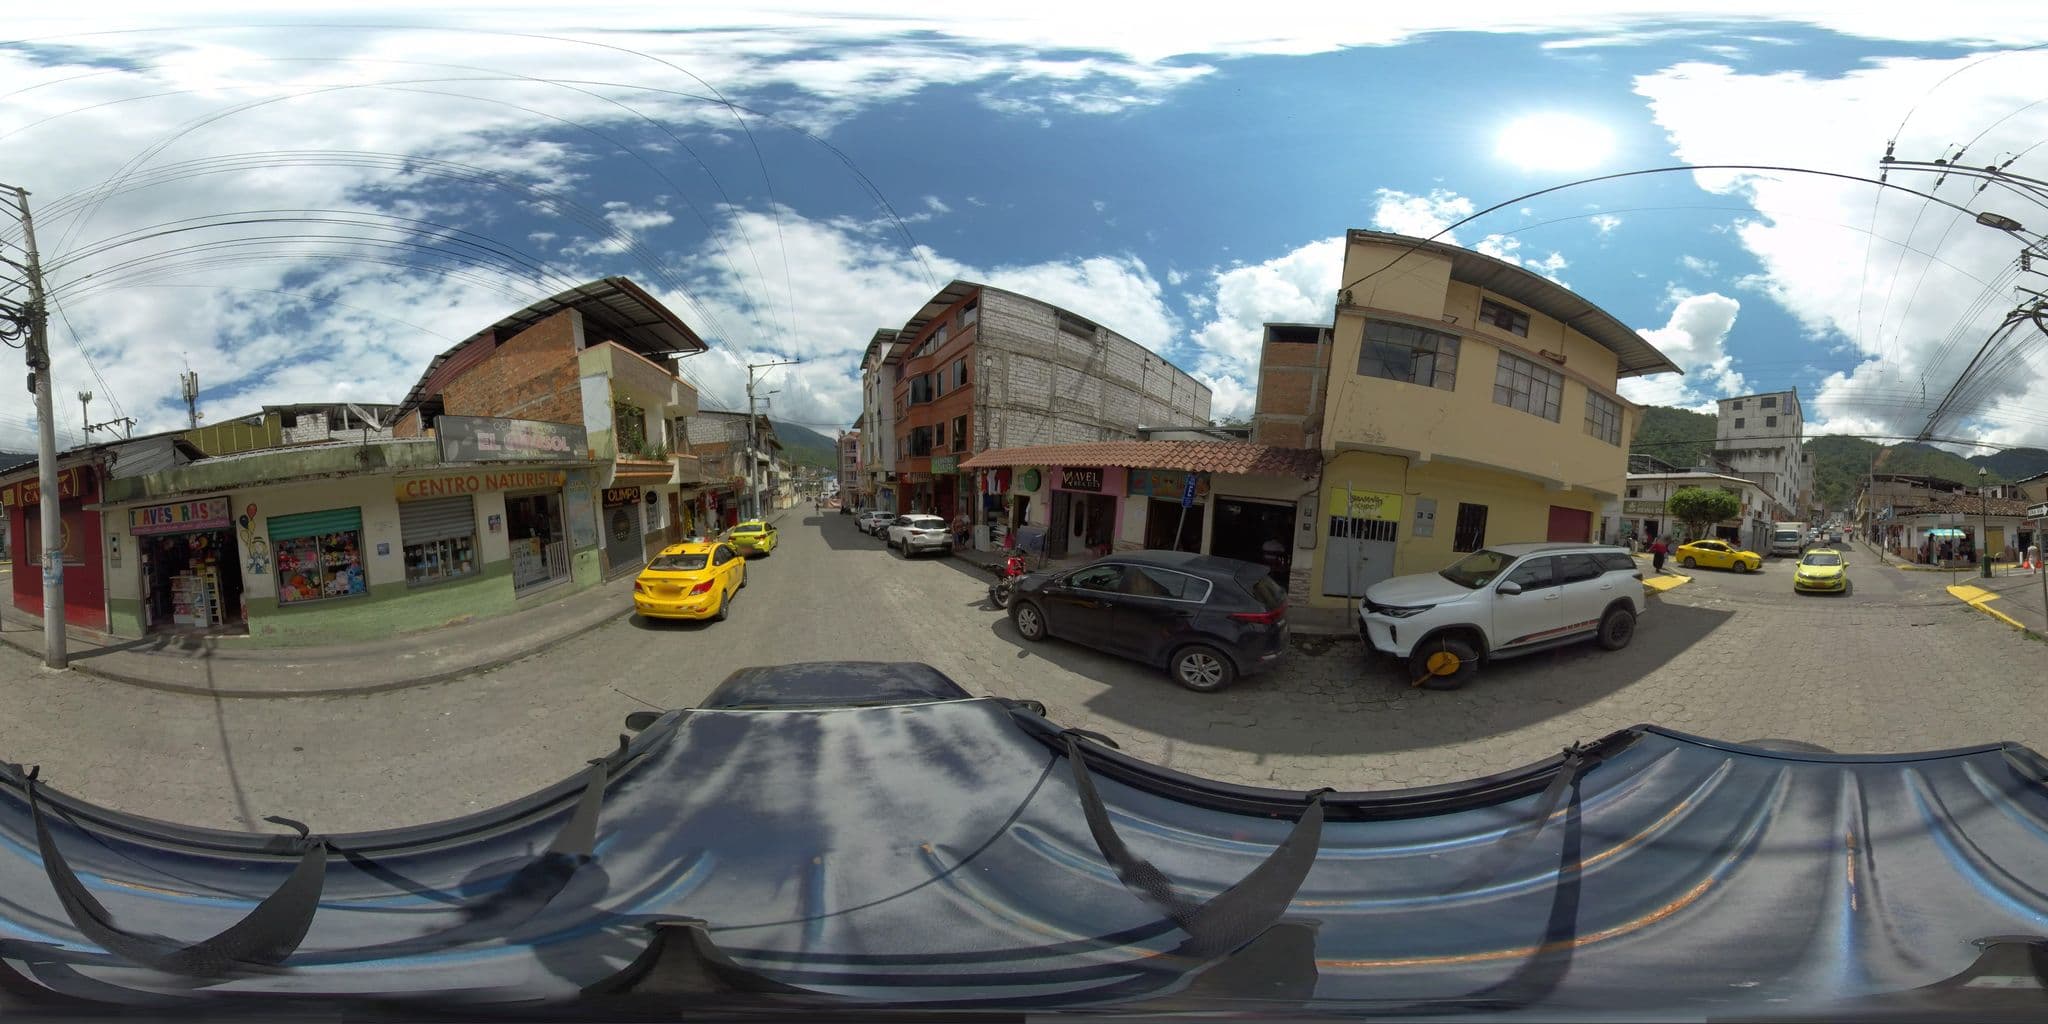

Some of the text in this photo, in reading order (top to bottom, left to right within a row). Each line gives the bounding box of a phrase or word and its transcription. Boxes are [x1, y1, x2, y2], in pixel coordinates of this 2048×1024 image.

[477, 432, 501, 451] EL
[405, 475, 480, 497] CENTRO
[485, 472, 561, 490] NATURISTA
[607, 487, 639, 502] OLIMPO
